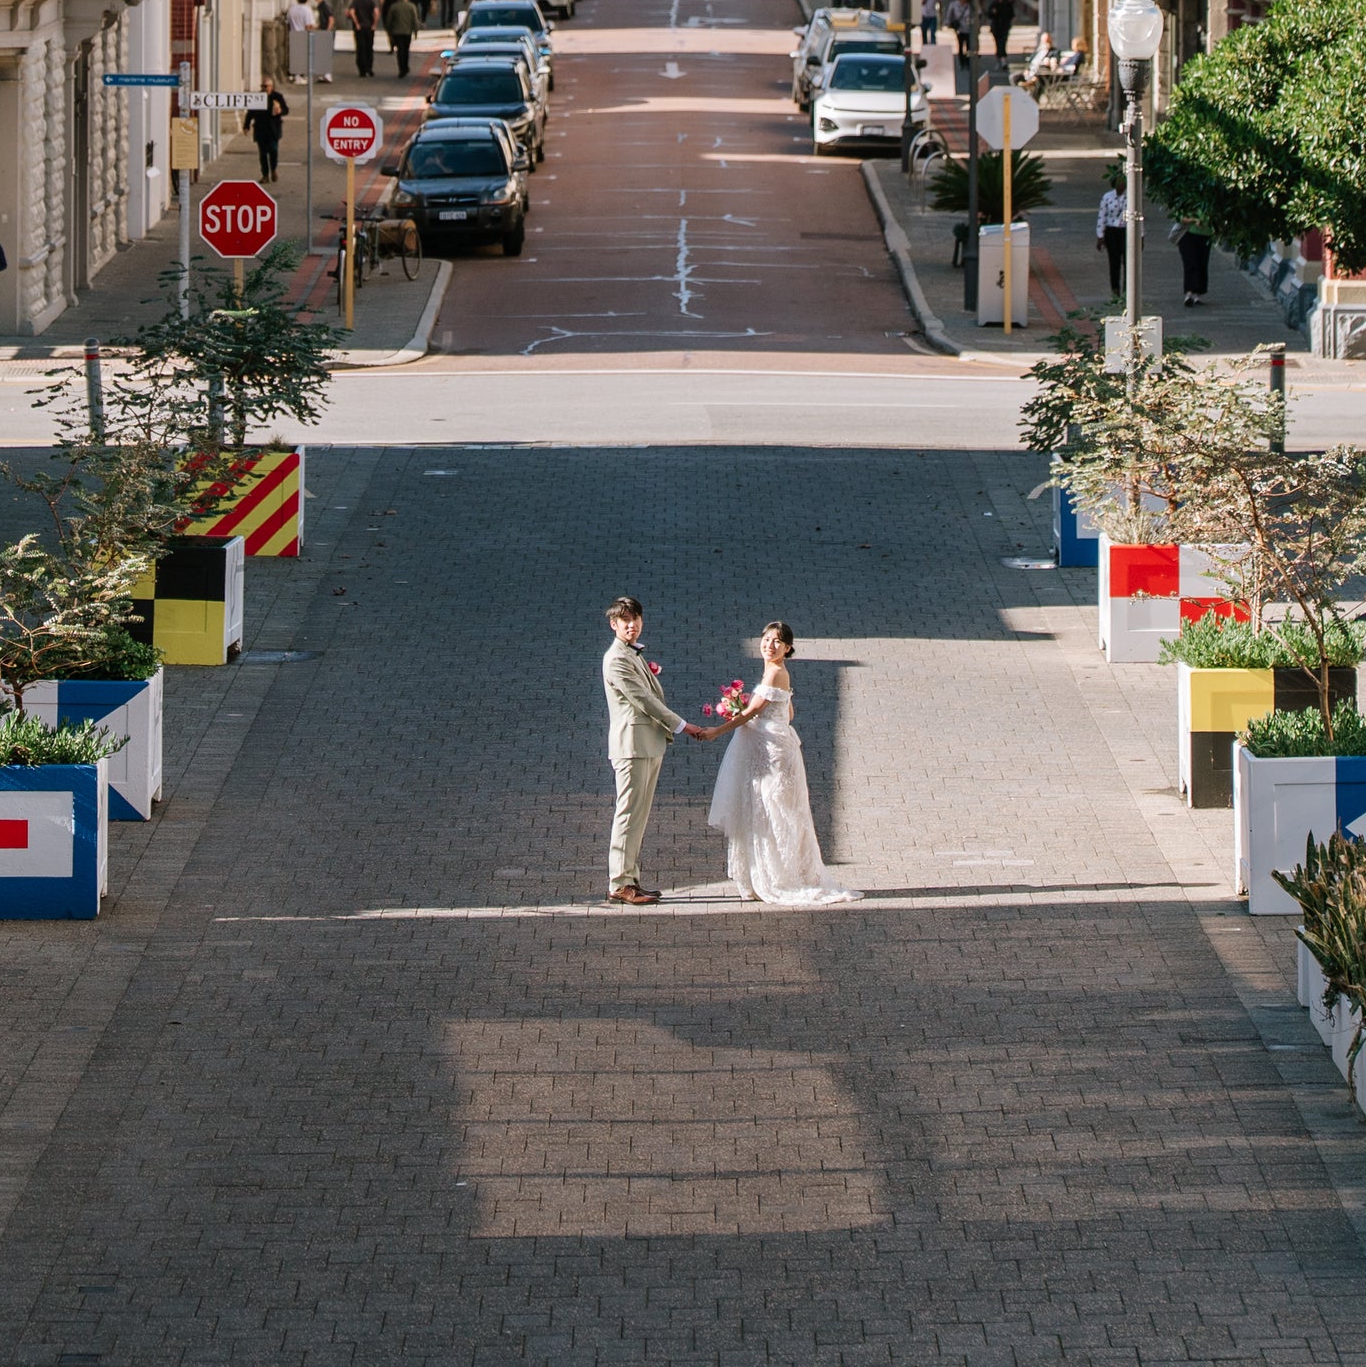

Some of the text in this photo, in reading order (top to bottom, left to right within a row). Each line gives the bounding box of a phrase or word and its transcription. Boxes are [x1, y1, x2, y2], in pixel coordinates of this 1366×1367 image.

[203, 94, 253, 107] CLIFF
[343, 115, 359, 127] NO
[333, 139, 369, 150] ENTRY
[205, 204, 272, 233] STOP
